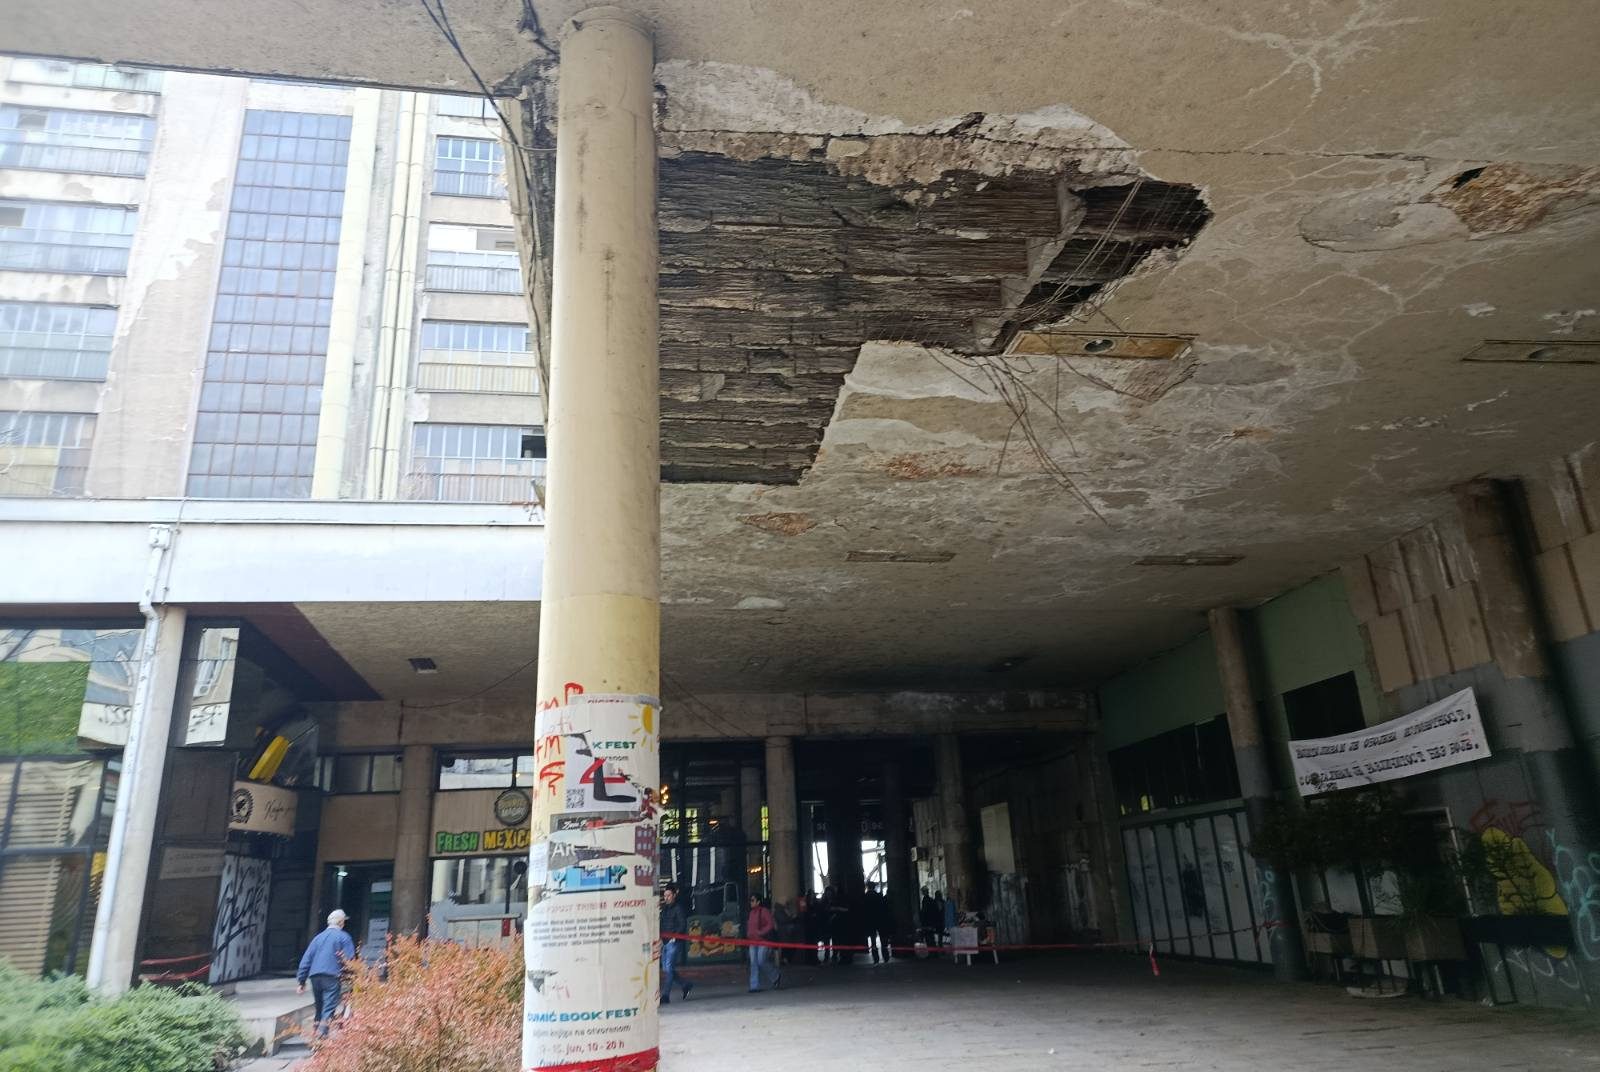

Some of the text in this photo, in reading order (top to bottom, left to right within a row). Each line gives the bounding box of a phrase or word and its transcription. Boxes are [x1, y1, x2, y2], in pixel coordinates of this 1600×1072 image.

[605, 741, 637, 750] FEST
[437, 832, 479, 853] FRESH
[559, 1009, 602, 1022] BOOK
[606, 1008, 639, 1020] FEST
